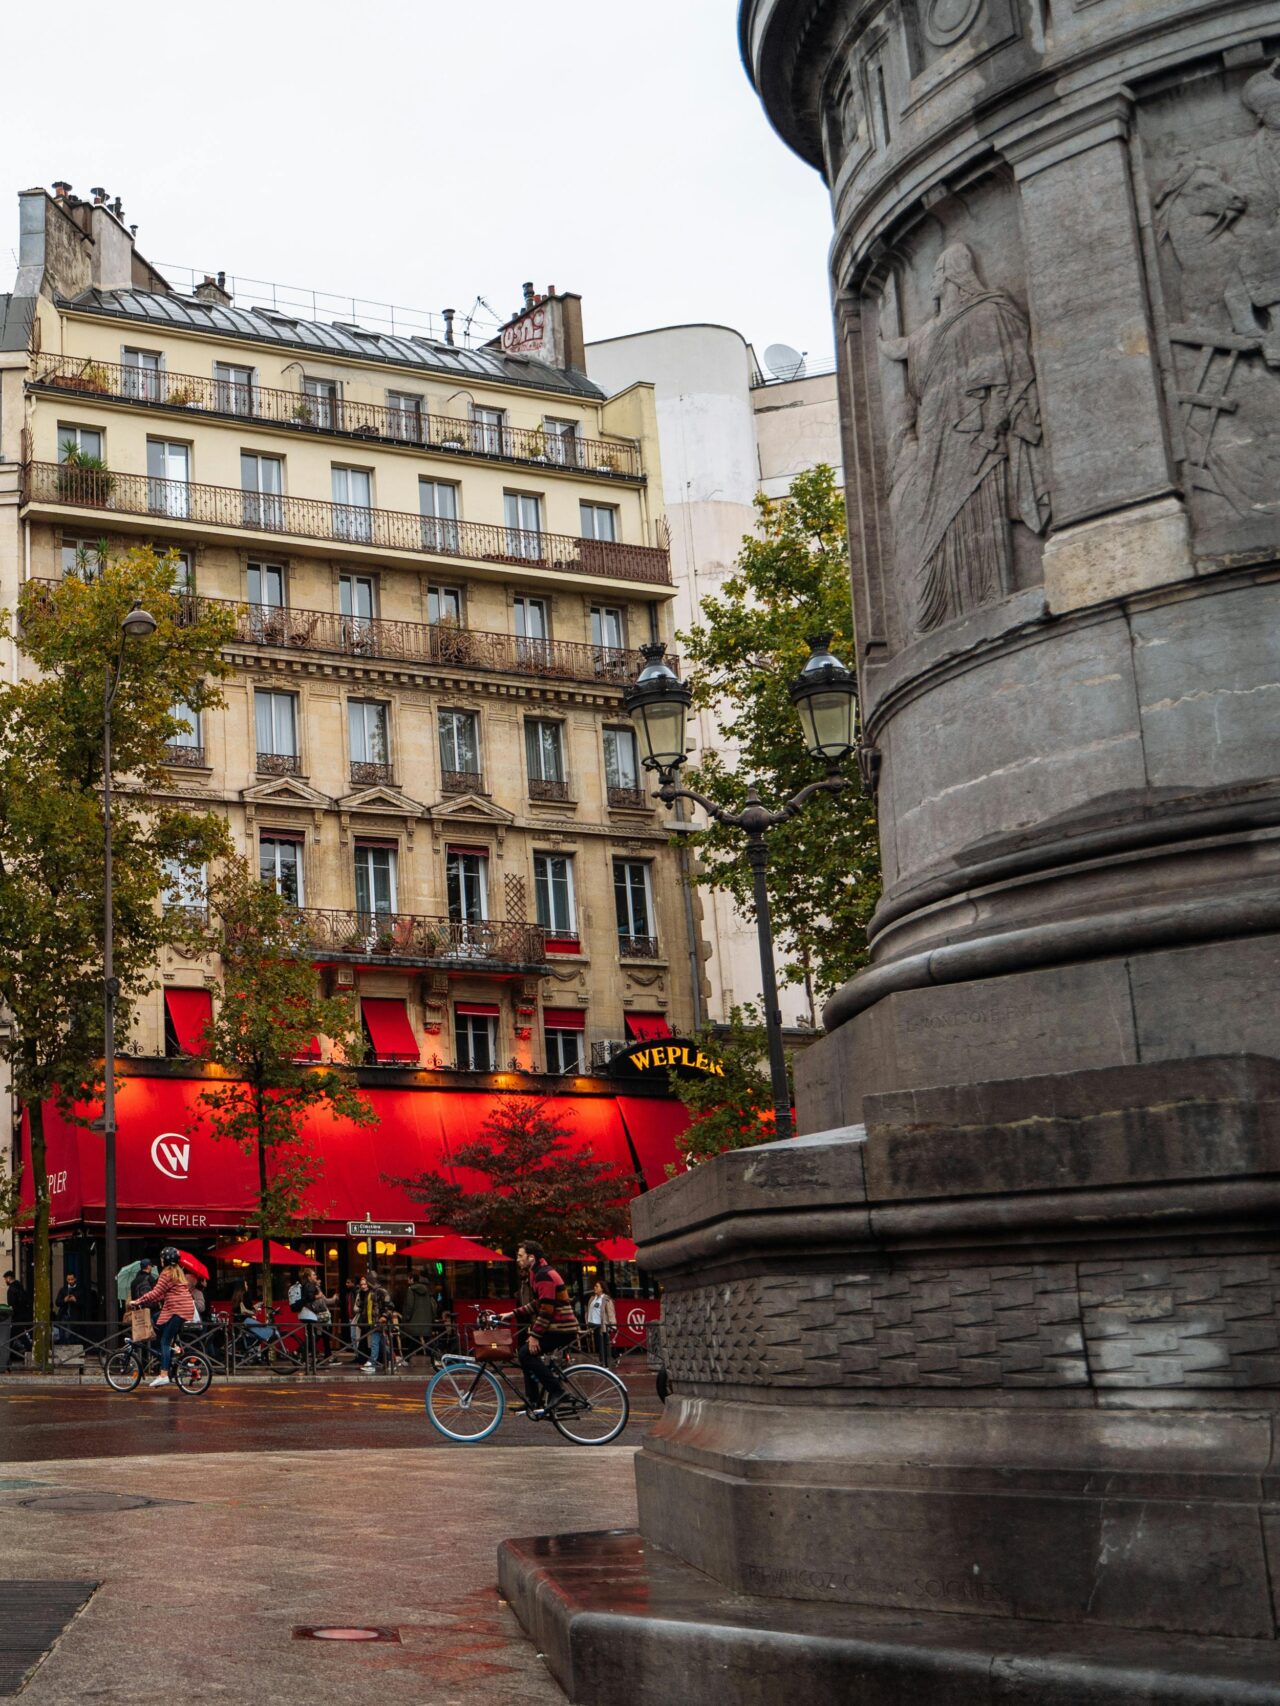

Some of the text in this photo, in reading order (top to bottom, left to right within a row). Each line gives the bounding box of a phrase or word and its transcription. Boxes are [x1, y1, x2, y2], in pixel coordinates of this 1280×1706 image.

[628, 1046, 725, 1077] WEPLER
[46, 1170, 68, 1195] PLER
[158, 1213, 208, 1227] WEPLER
